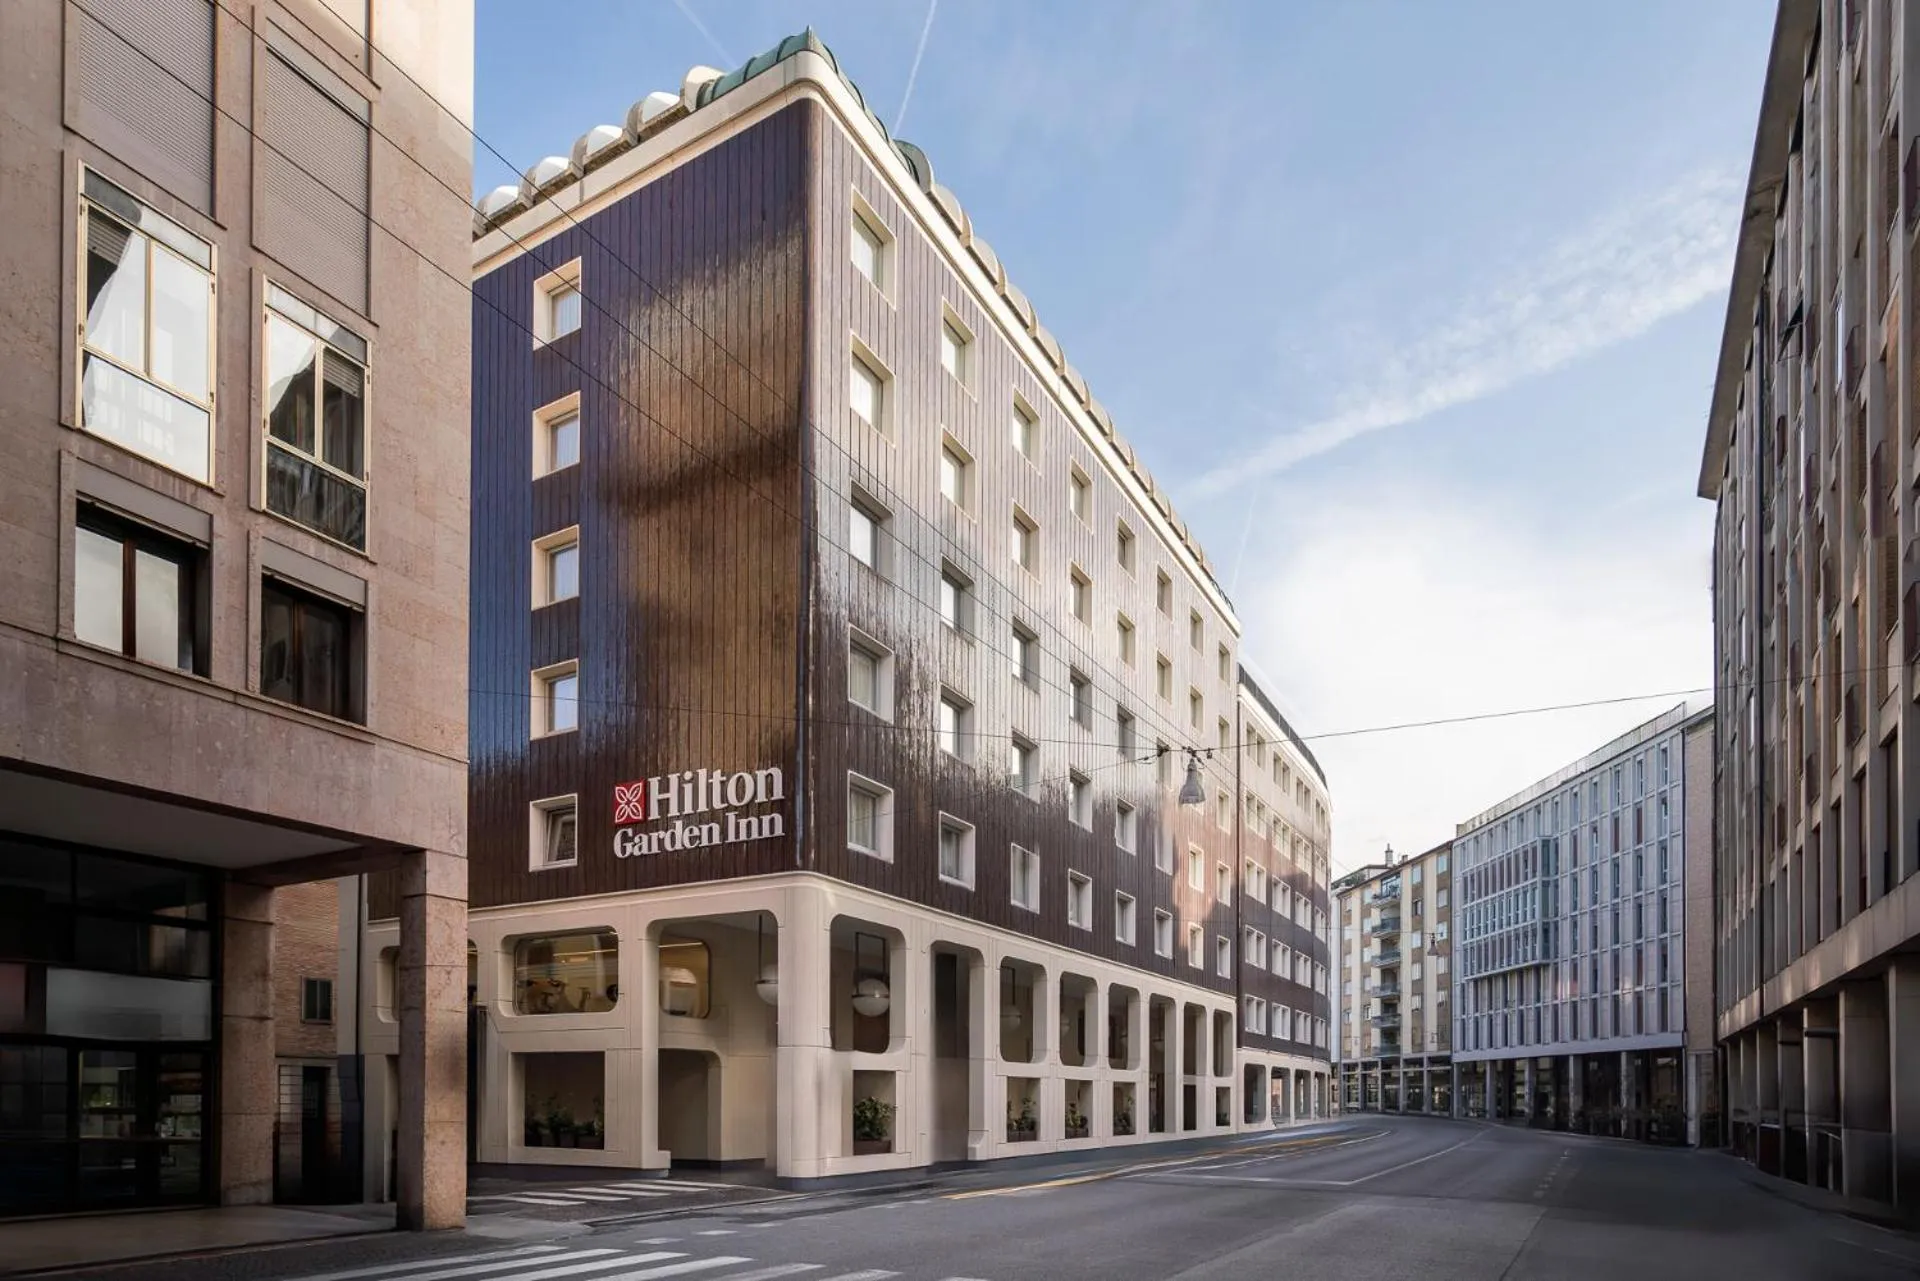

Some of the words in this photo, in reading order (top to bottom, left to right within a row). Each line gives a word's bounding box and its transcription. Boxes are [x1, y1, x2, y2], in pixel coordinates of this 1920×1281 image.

[648, 767, 785, 820] Hilton
[613, 820, 722, 859] Garden
[725, 811, 785, 844] Inn
